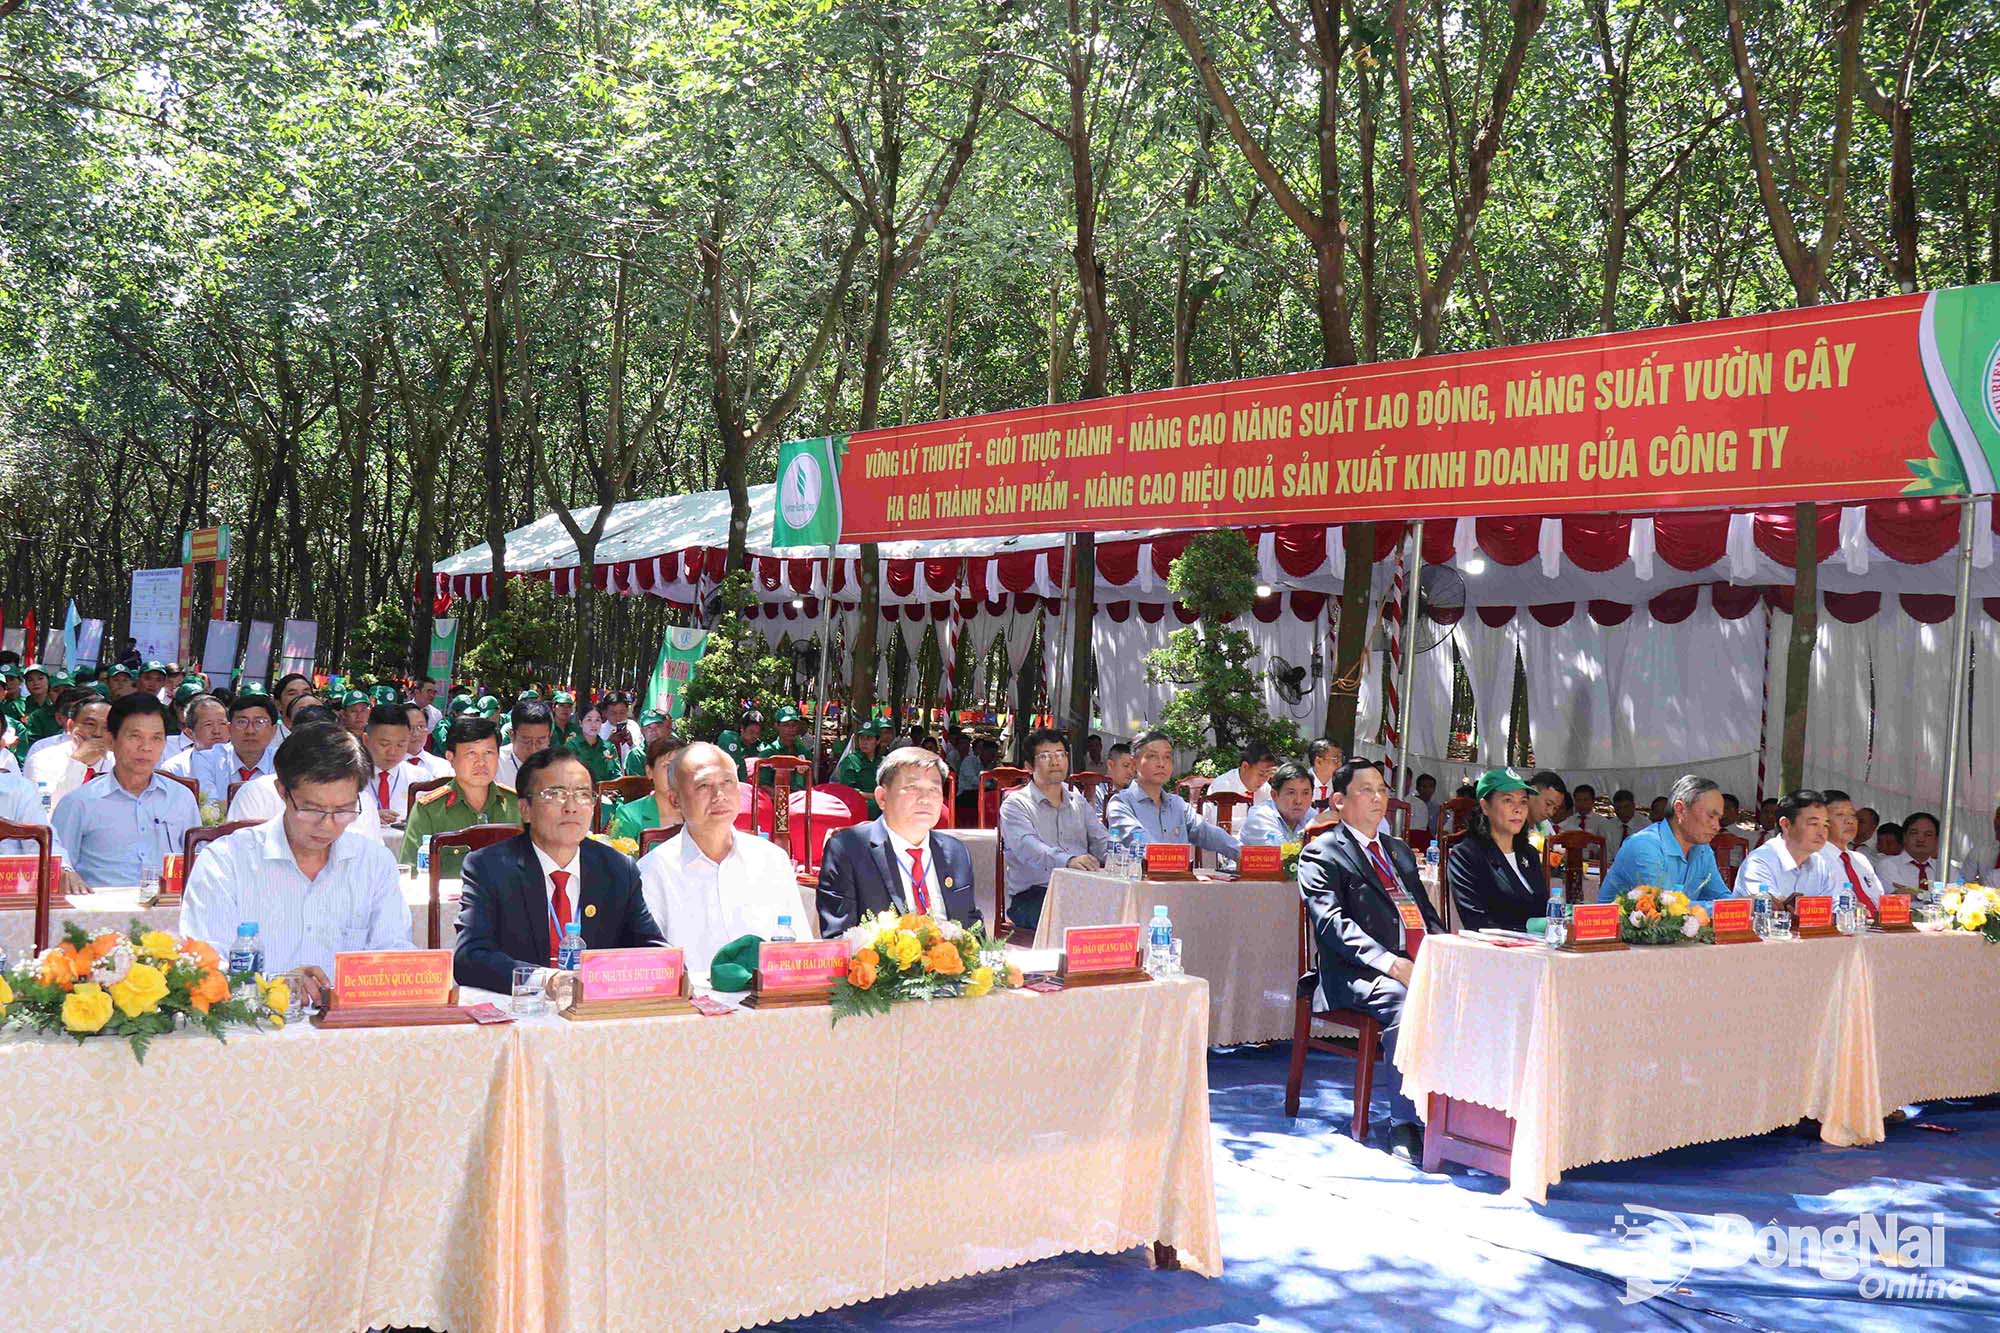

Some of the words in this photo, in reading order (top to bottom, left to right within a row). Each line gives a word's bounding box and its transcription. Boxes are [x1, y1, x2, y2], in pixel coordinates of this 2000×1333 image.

[866, 448, 899, 479] VỮNG
[902, 443, 918, 475] LÝ
[922, 434, 972, 473] THUYẾT
[985, 427, 1017, 465] GIỎI
[1021, 429, 1061, 467] THỰC
[1065, 421, 1112, 458] HÀNH
[1129, 413, 1181, 452] NÂNG
[1187, 412, 1226, 447] CAO
[1232, 401, 1292, 443] NĂNG
[1299, 386, 1358, 437] SUẤT
[1364, 392, 1409, 431] LAO
[1416, 380, 1496, 431] ĐỘNG,
[1505, 370, 1585, 418] NĂNG
[1594, 351, 1674, 410] SUẤT
[1683, 345, 1773, 402] VƯỜN
[1784, 336, 1856, 392] CÂY
[886, 495, 904, 527] HẠ
[908, 487, 930, 520] GIÁ
[935, 484, 982, 518] THÀNH
[985, 476, 1017, 515] SẢN
[1021, 470, 1069, 511] PHẨM
[1084, 472, 1134, 508] NÂNG
[1139, 472, 1176, 505] CAO
[1181, 463, 1227, 509] HIỆU
[1232, 454, 1275, 503] QUẢ
[1282, 451, 1328, 498] SẢN
[1335, 444, 1397, 494] XUẤT
[1404, 451, 1466, 490] KINH
[1474, 444, 1569, 486] DOANH
[1578, 426, 1638, 481] CỦA
[1649, 425, 1737, 476] CÔNG
[1749, 426, 1789, 470] TY
